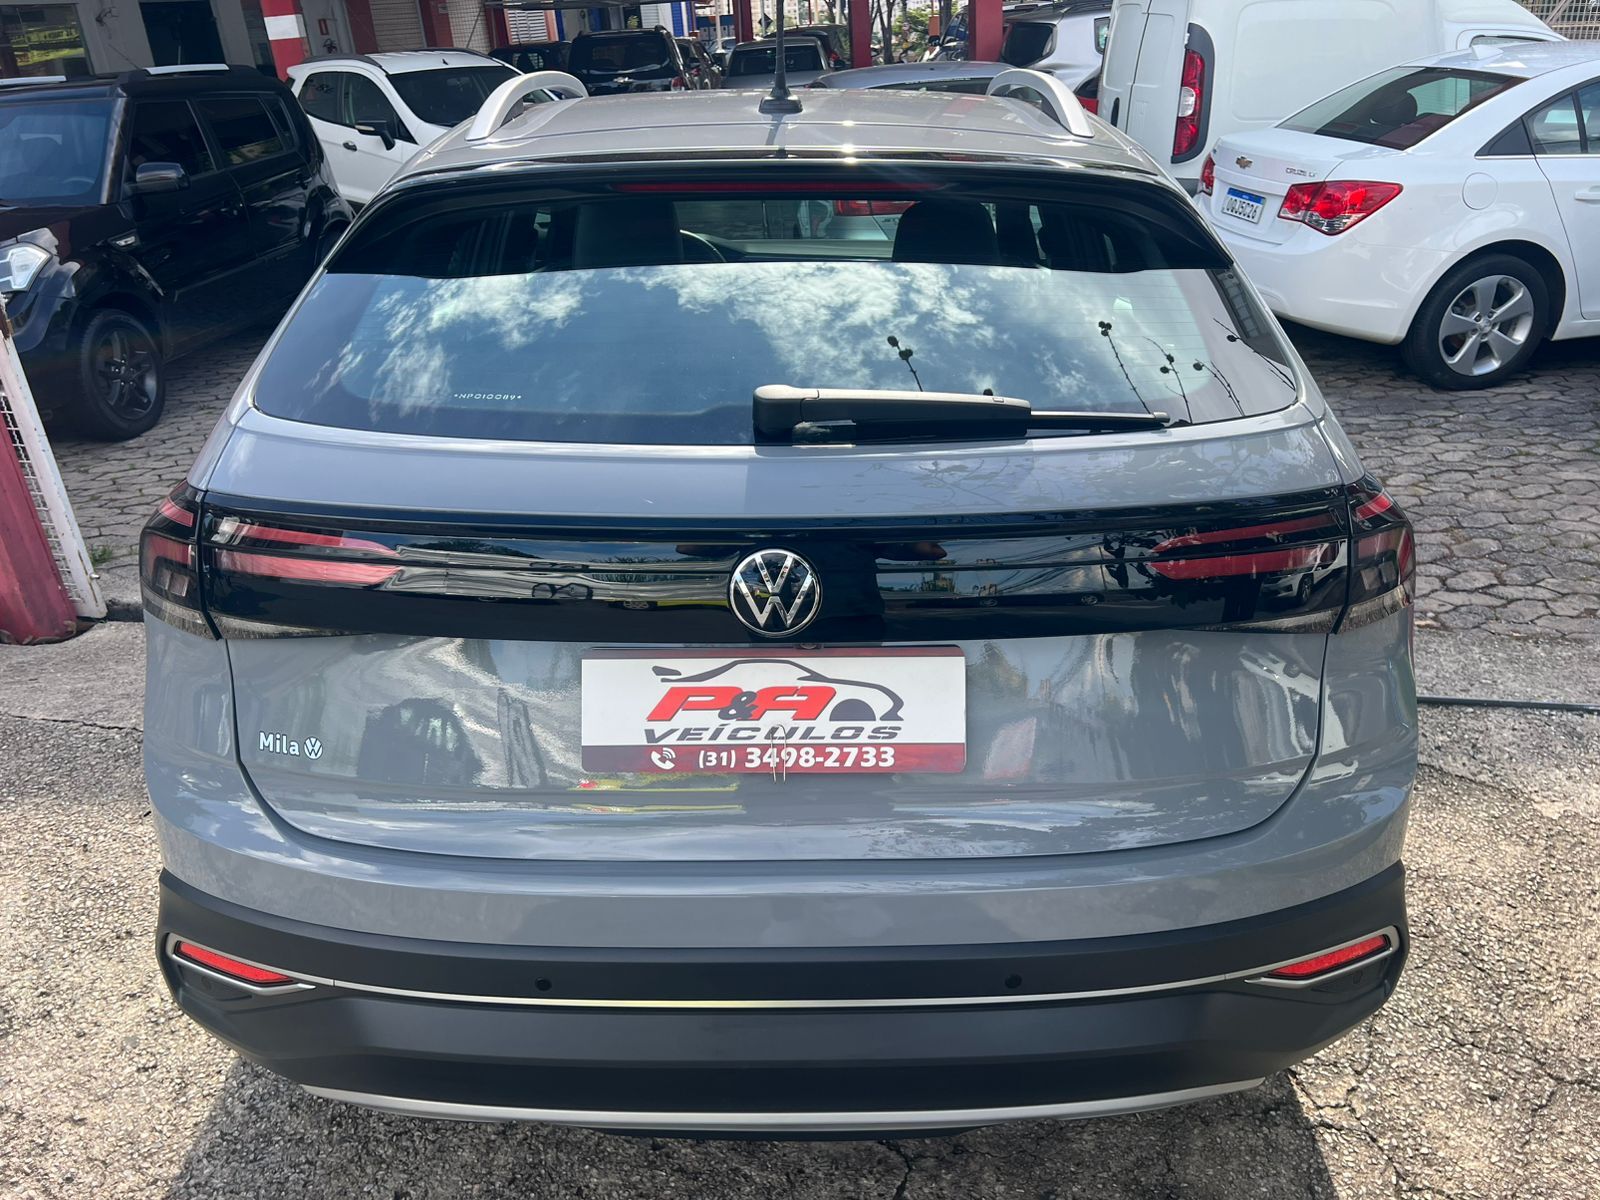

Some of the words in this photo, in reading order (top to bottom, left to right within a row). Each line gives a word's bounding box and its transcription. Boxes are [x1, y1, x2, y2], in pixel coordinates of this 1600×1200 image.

[646, 686, 837, 722] P&A
[259, 731, 300, 756] Mila
[644, 722, 904, 744] VEÍCULOS
[698, 749, 736, 769] (31)
[745, 746, 895, 768] 3498-2733
